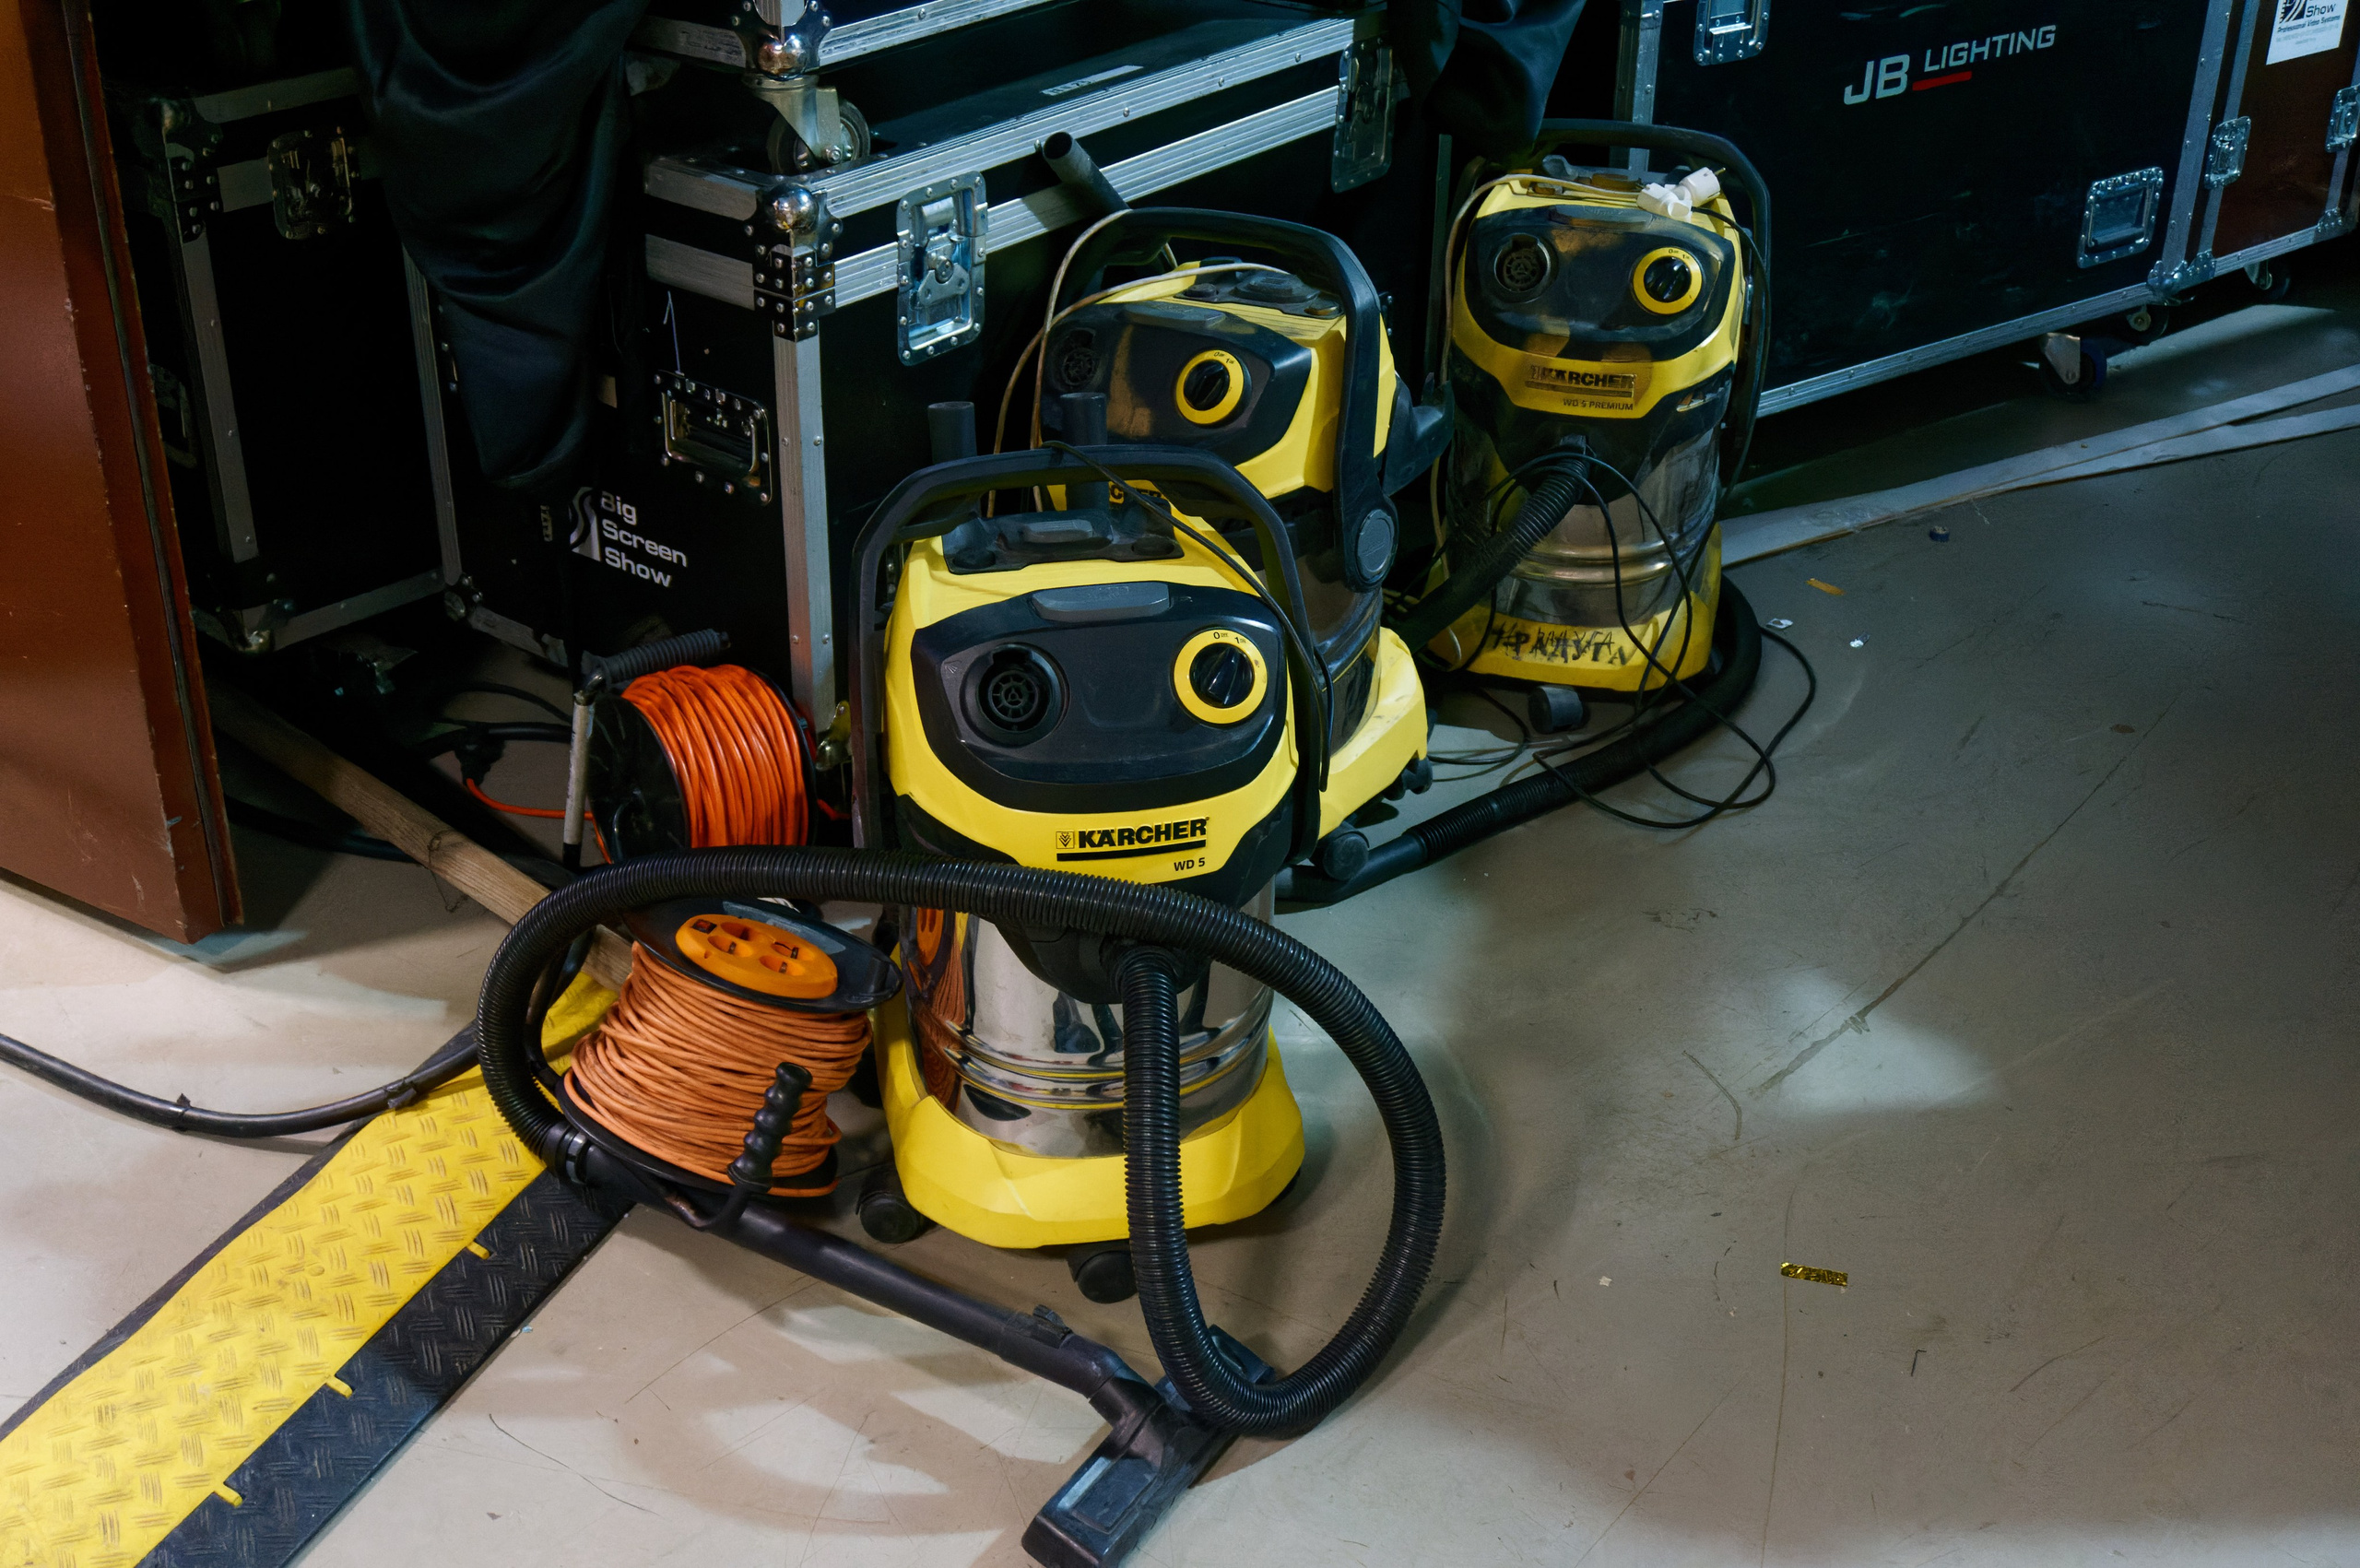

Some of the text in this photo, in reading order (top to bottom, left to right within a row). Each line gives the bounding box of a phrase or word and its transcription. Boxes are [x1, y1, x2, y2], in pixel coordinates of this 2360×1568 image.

[2306, 4, 2336, 18] Show
[1844, 25, 2057, 105] JB LIGHTING
[1563, 398, 1579, 407] WD
[1589, 401, 1634, 411] PREMIUM
[601, 490, 637, 525] Big
[602, 518, 688, 568] Screen
[605, 546, 672, 587] Show
[1079, 818, 1207, 849] KÄRCHER
[1174, 857, 1206, 872] WD 5
